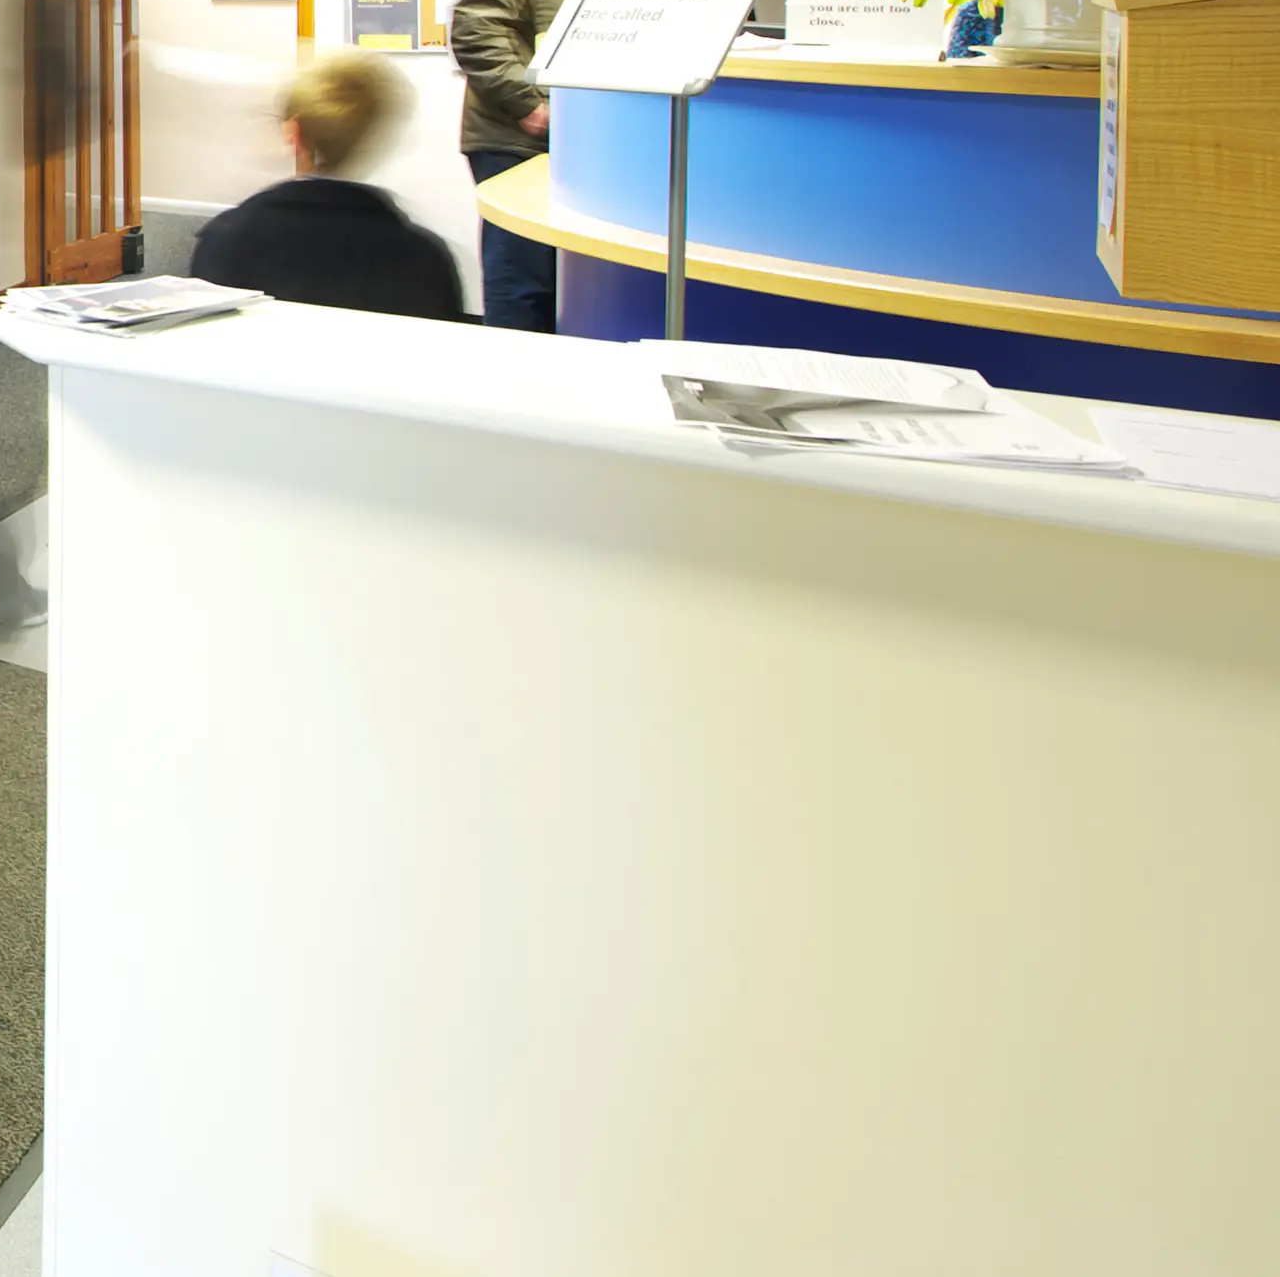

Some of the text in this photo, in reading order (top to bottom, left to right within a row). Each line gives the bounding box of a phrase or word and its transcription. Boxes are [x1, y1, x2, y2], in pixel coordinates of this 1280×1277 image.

[580, 8, 665, 22] are called
[810, 5, 833, 14] you
[864, 5, 884, 13] not
[889, 5, 910, 13] too
[810, 17, 845, 26] close.
[569, 27, 639, 44] forward
